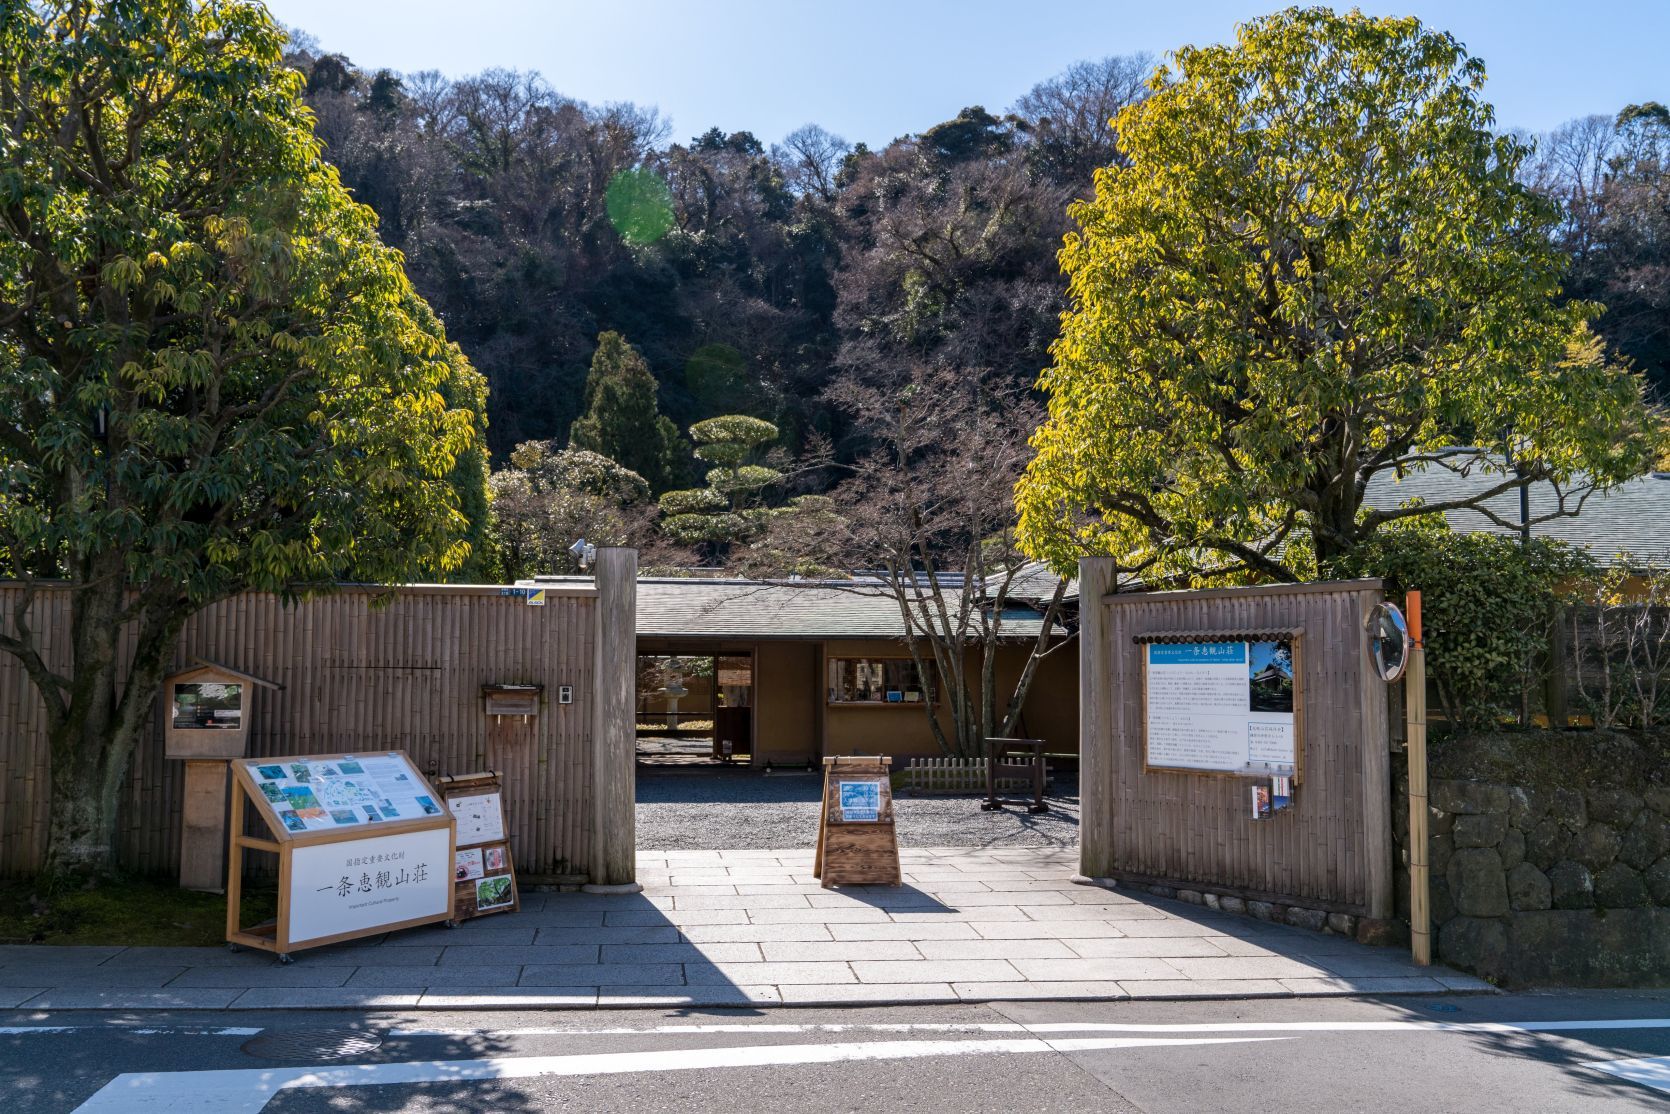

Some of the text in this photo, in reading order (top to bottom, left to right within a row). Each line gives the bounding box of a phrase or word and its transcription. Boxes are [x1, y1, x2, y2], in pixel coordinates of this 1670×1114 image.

[1185, 645, 1234, 656] 一条恵観山荘
[316, 862, 428, 898] 一条恵観山荘
